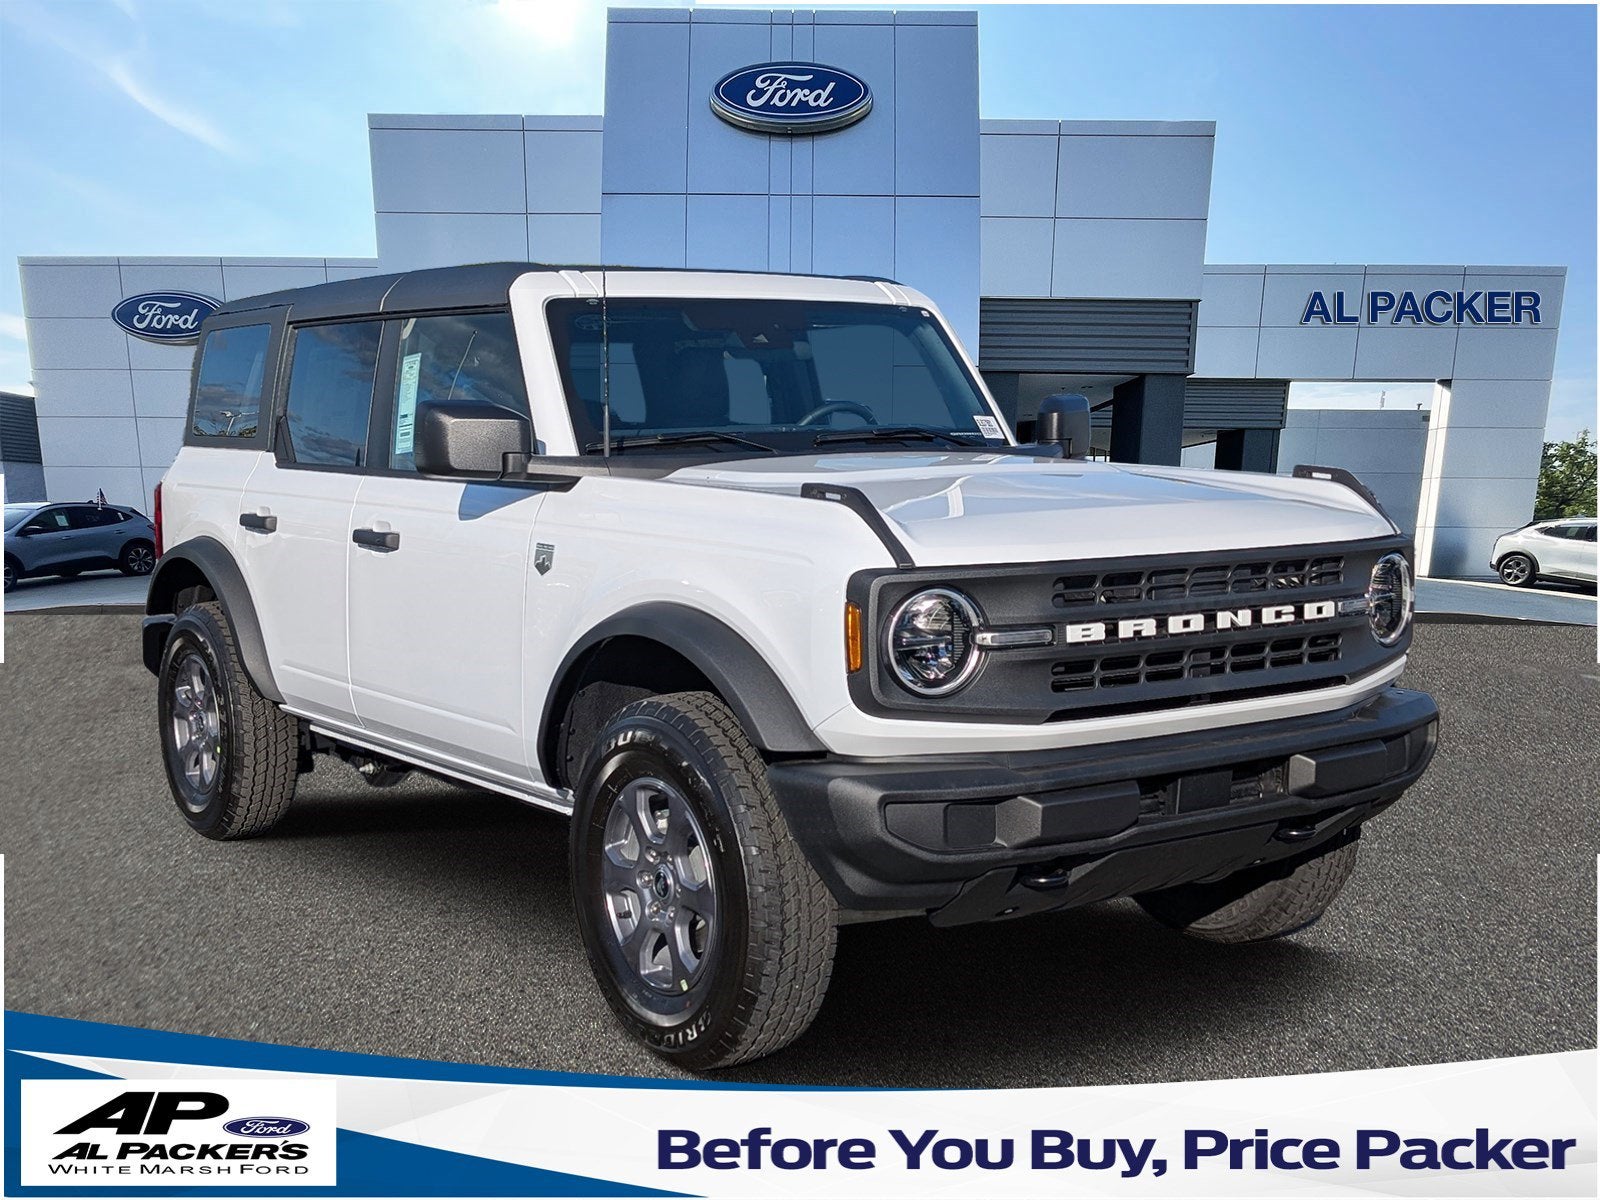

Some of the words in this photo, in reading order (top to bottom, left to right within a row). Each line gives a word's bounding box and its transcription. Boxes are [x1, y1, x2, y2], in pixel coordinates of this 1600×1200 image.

[746, 73, 836, 107] Ford
[133, 300, 199, 329] Ford
[1301, 290, 1360, 324] AL
[1368, 290, 1543, 325] PACKER
[1066, 601, 1335, 643] BRONCO
